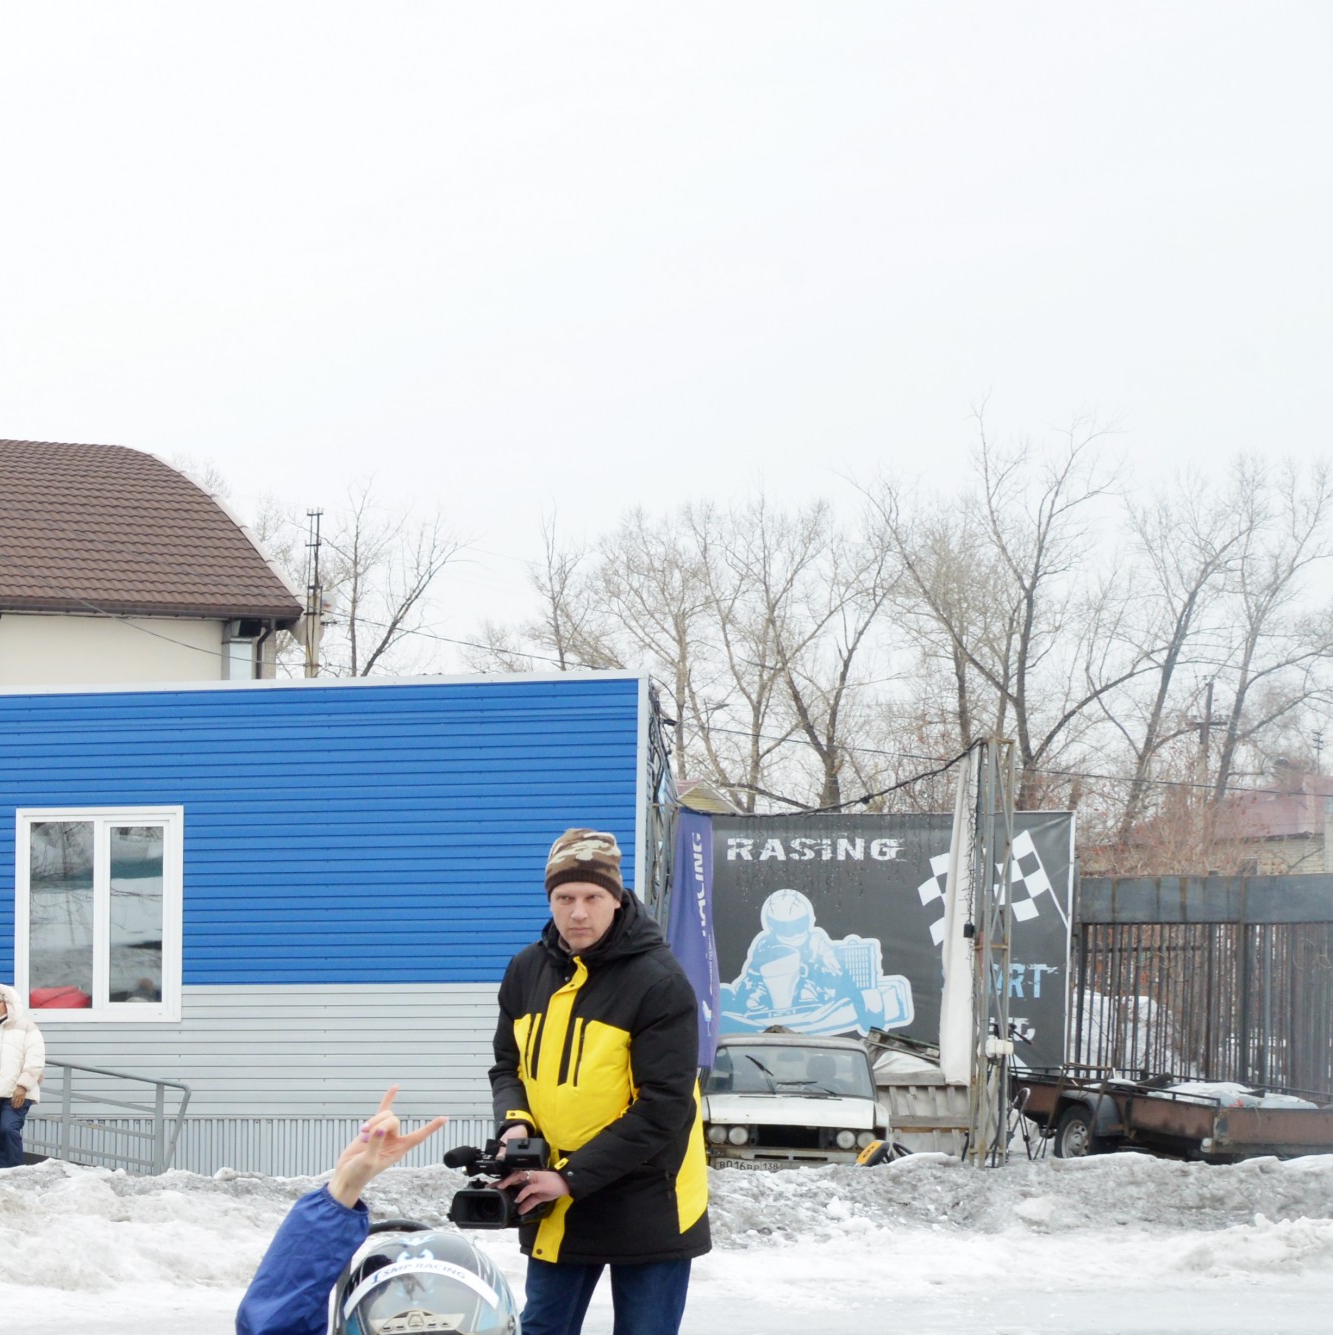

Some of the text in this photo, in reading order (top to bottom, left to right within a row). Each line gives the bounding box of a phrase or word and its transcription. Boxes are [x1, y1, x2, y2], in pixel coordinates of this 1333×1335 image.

[727, 833, 906, 862] RASING
[383, 1262, 465, 1279] SMP RACING
